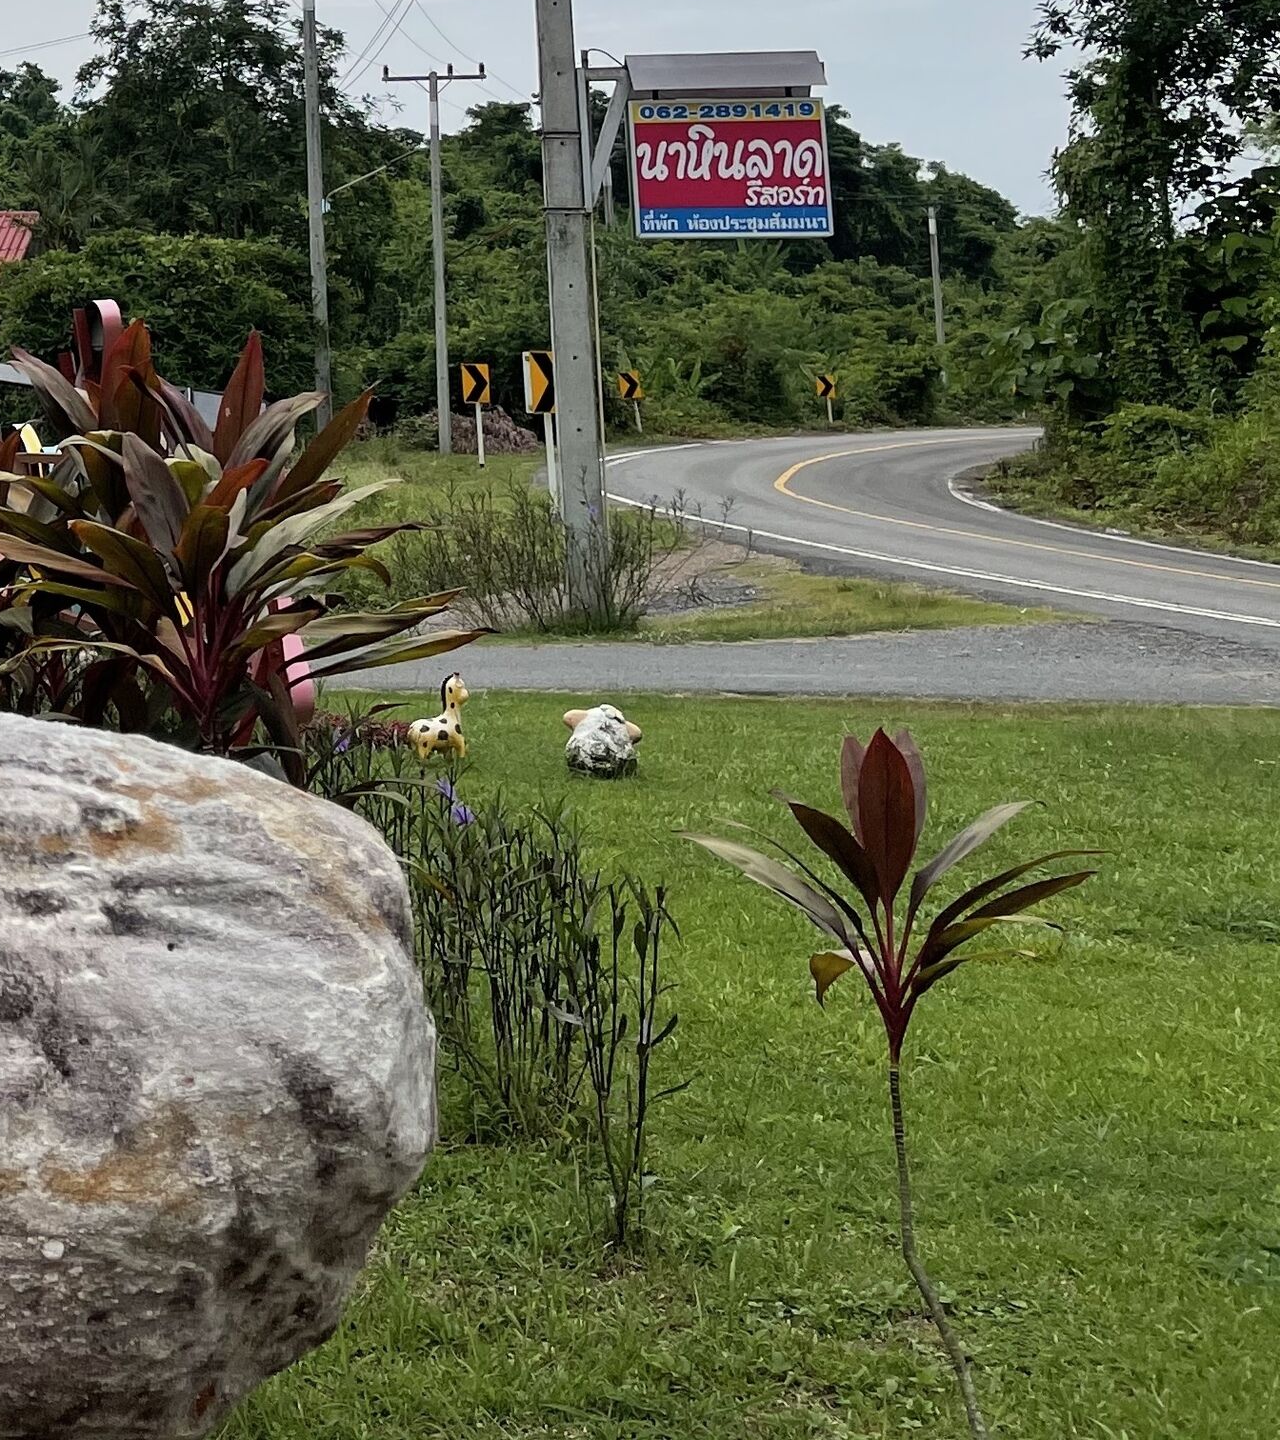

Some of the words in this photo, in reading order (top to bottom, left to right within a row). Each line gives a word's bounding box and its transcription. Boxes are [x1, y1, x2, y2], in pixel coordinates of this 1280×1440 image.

[639, 101, 815, 120] 062-2891419
[636, 123, 823, 181] นาหินลาด
[745, 177, 825, 206] รีสอร์ท
[642, 209, 679, 231] ที่พัก
[686, 212, 827, 233] ห้องประชุมสัมมนา
